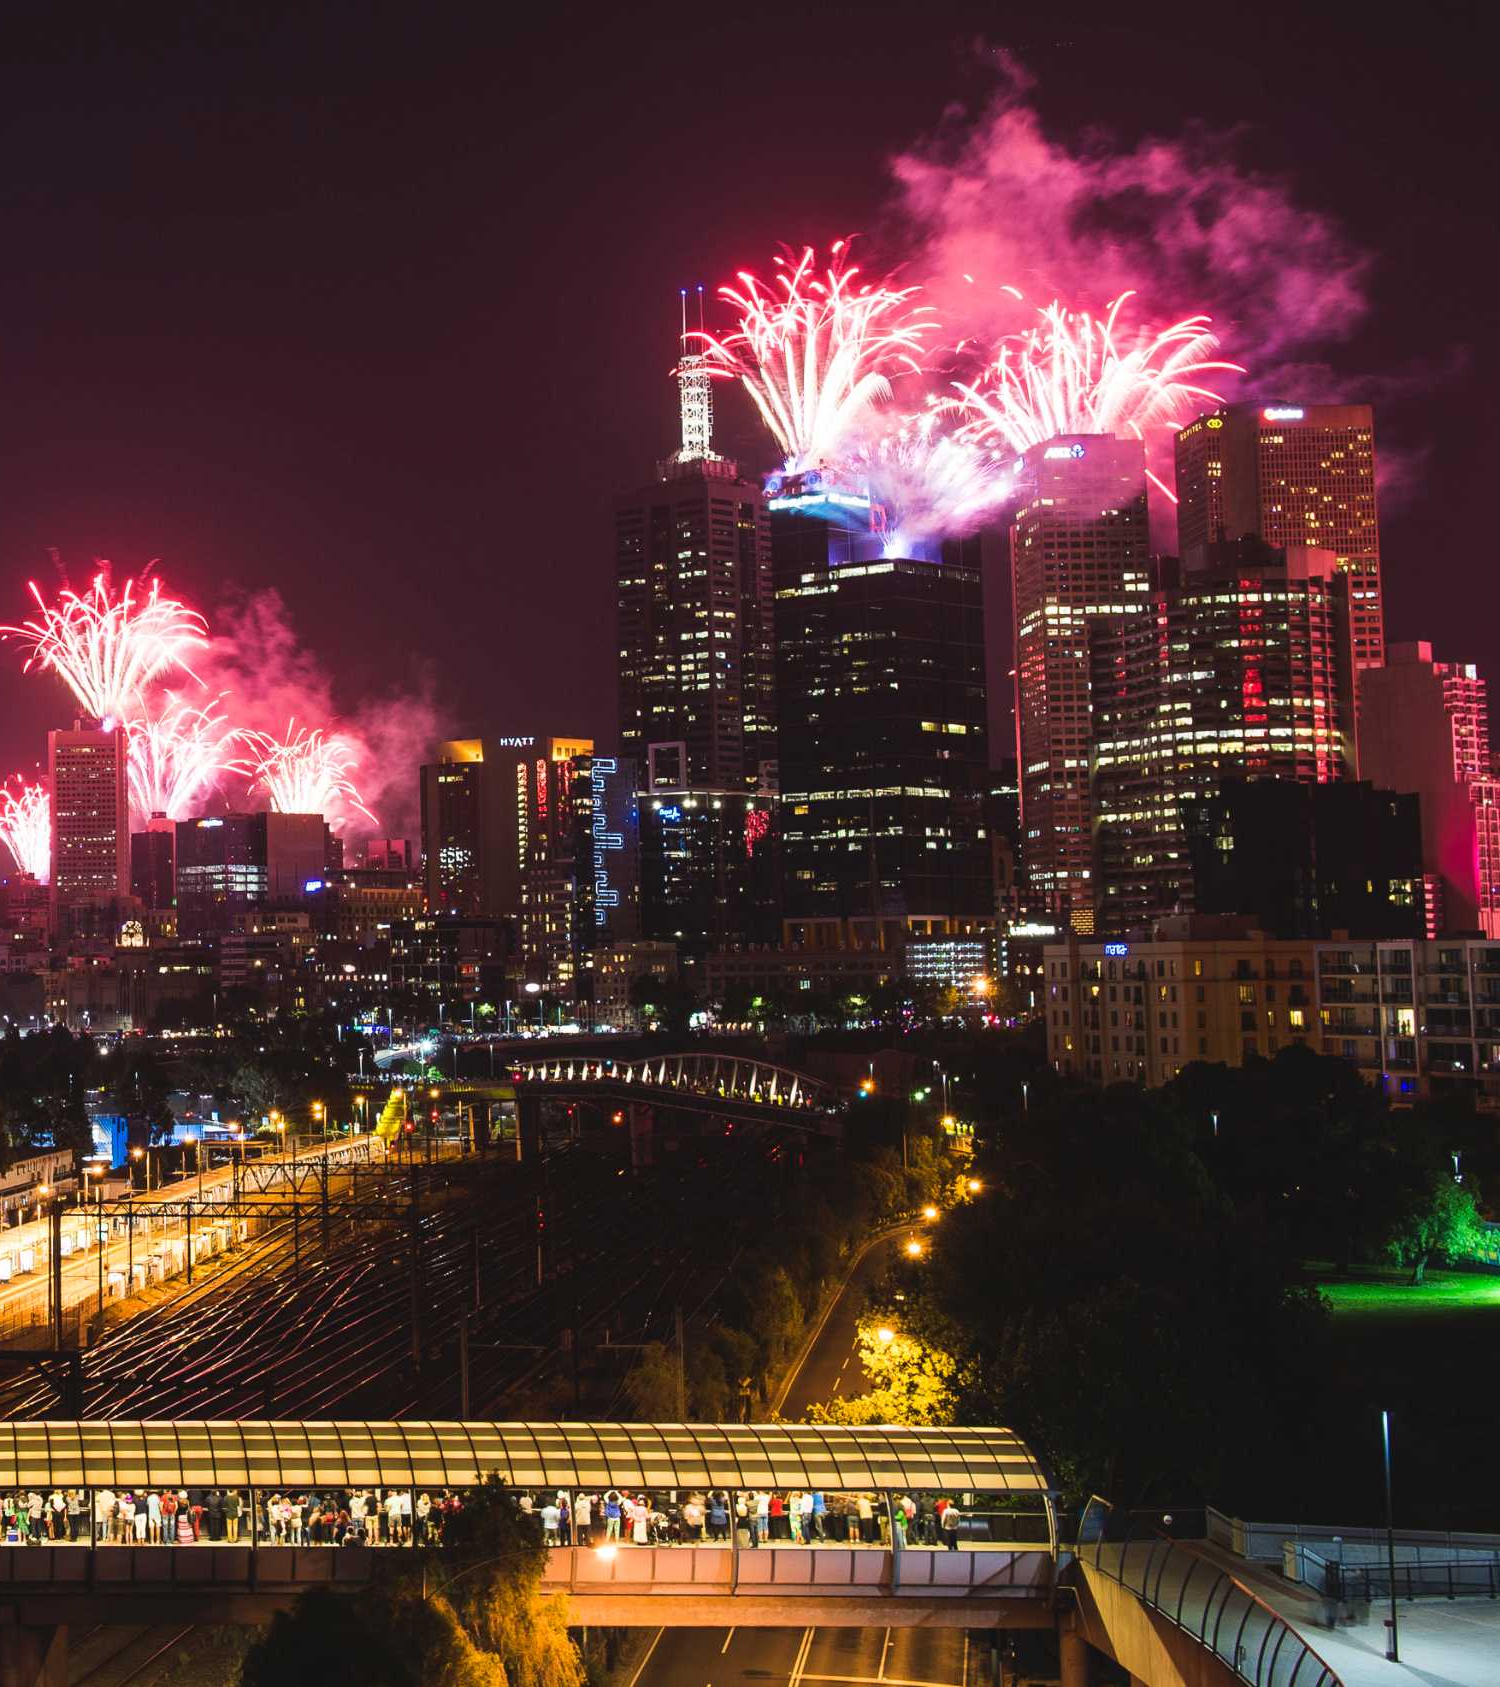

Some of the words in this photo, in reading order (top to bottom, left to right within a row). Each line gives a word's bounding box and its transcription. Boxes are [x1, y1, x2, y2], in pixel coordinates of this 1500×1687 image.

[1180, 422, 1202, 441] SOFITEL
[500, 737, 534, 747] HYATT
[719, 942, 799, 952] HERALD
[837, 940, 879, 951] SUN
